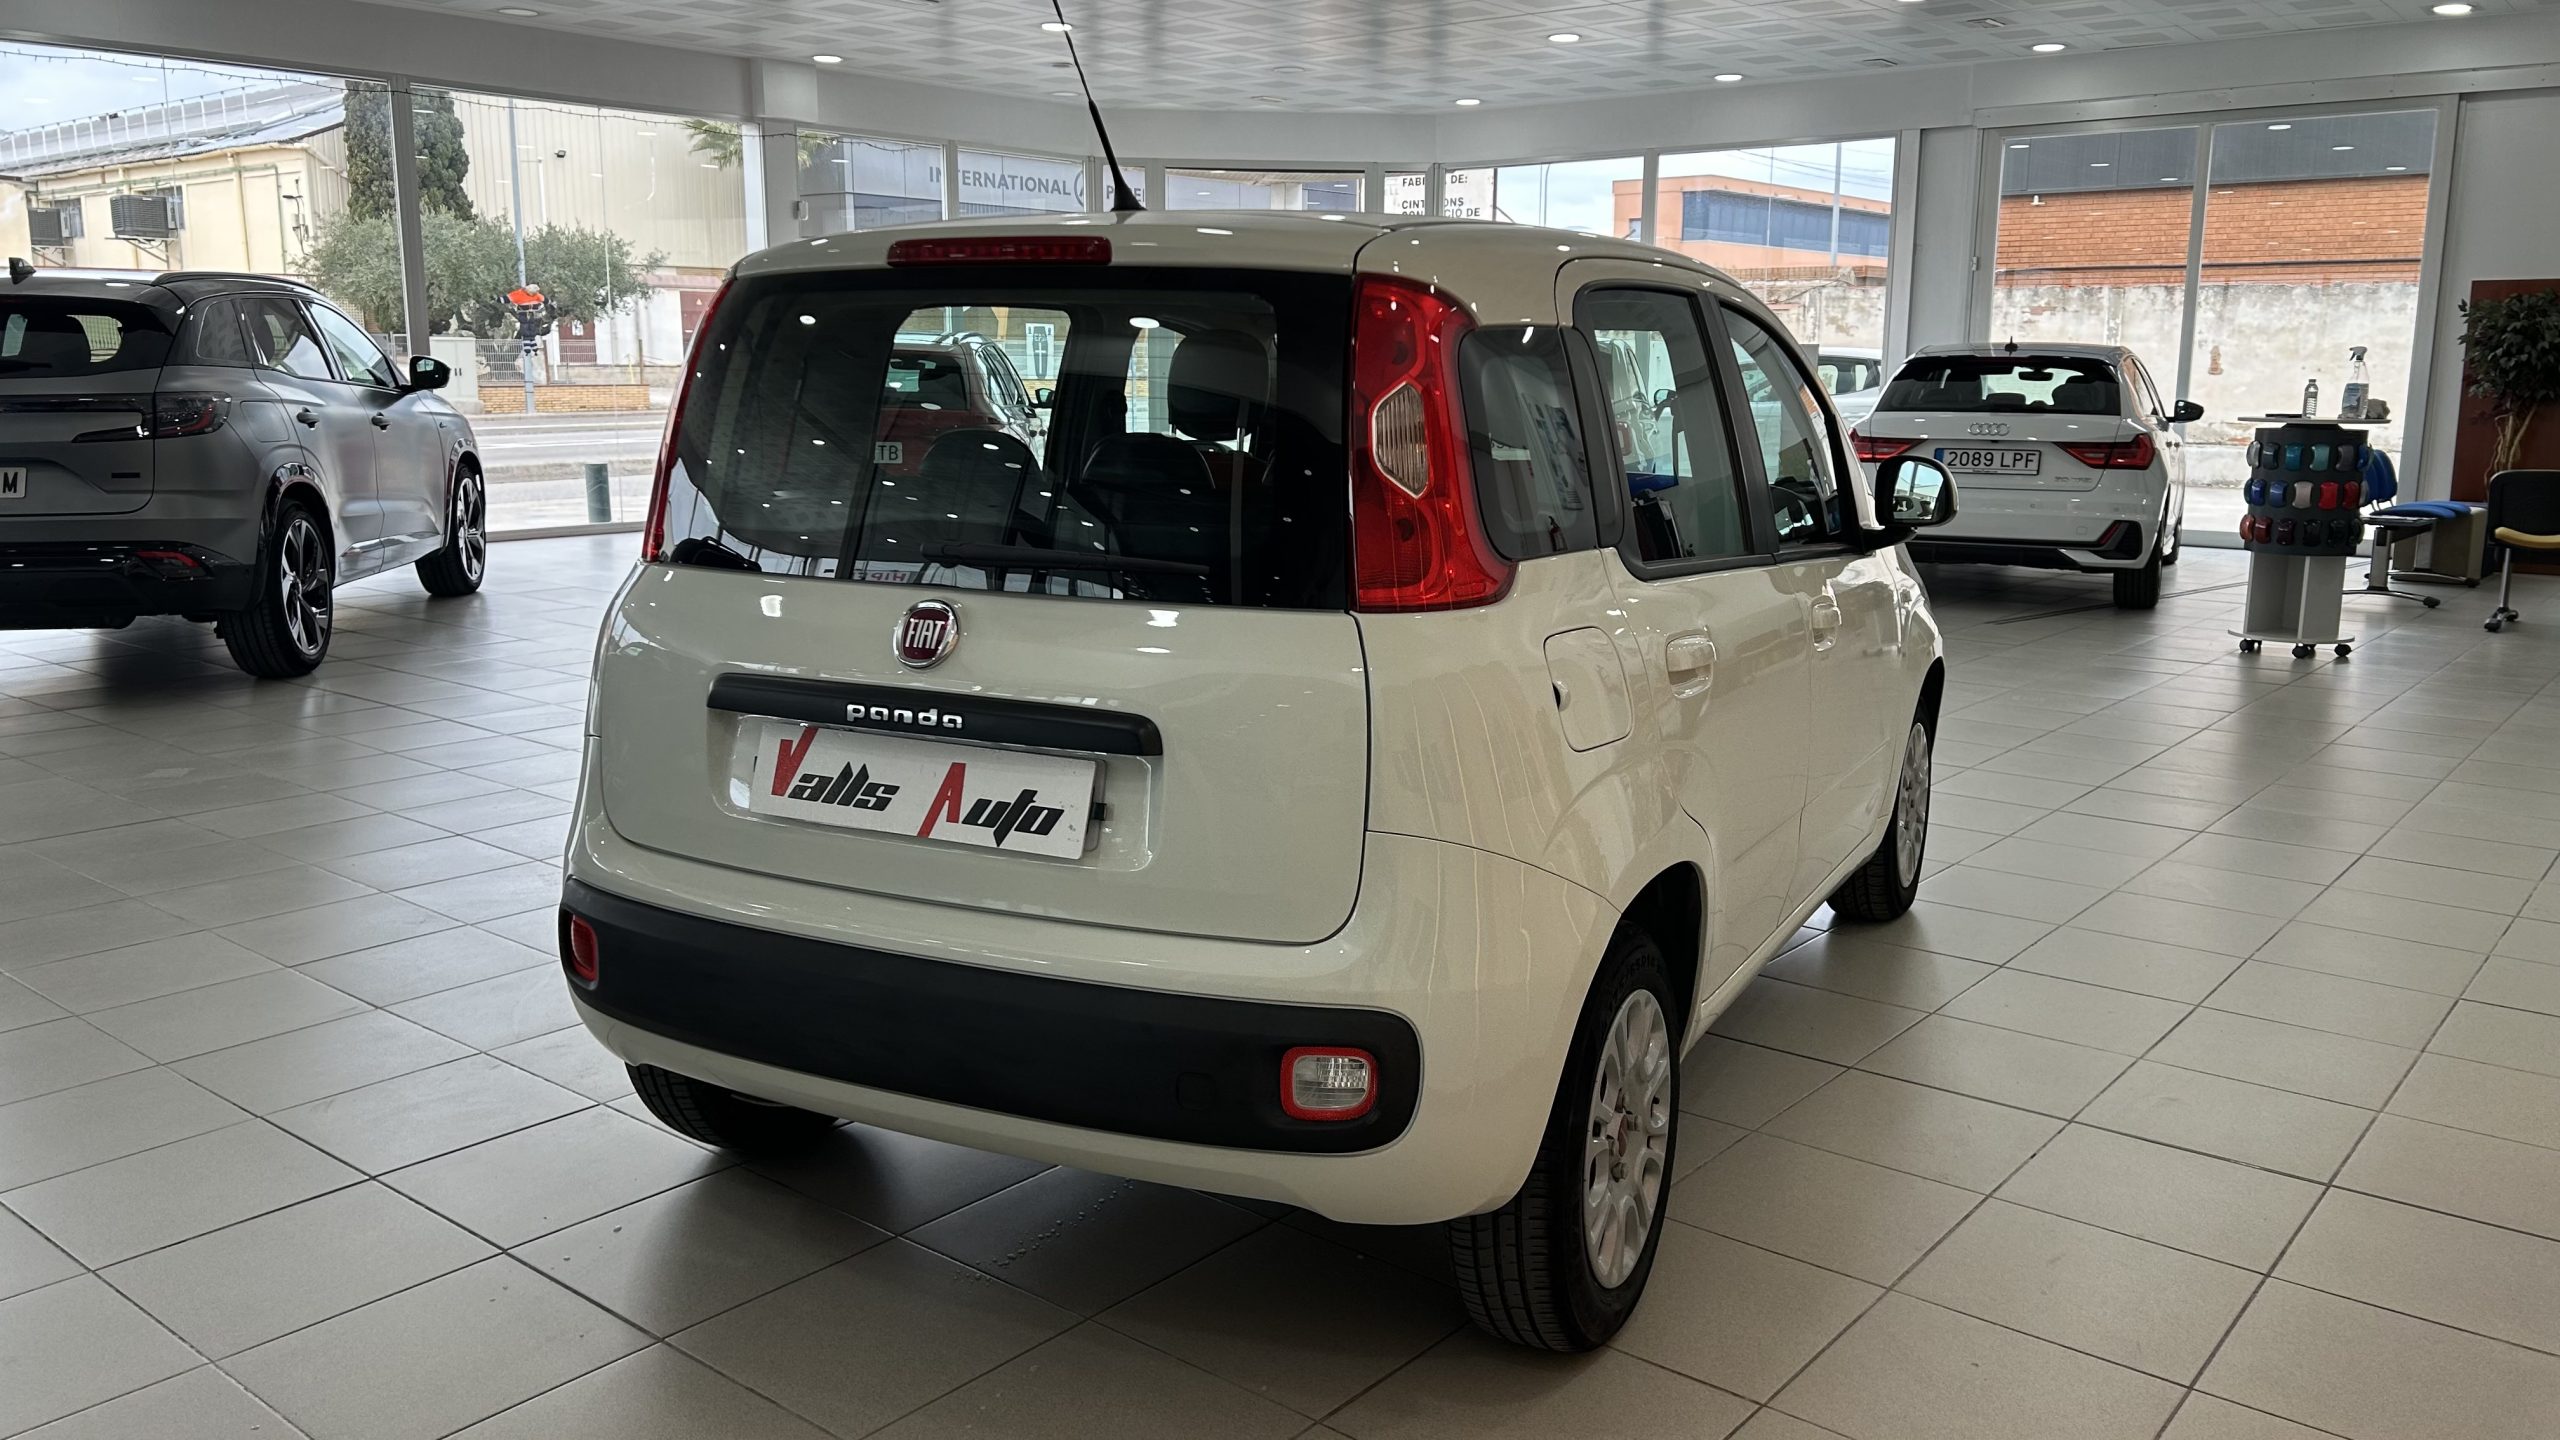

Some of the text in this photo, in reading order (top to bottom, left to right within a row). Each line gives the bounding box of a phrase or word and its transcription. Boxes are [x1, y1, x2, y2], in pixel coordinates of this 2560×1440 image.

[929, 166, 1071, 195] IERNATIONAL
[1450, 174, 1468, 184] DE:
[1466, 208, 1480, 217] DE
[1947, 451, 2036, 468] 2089 LPF
[2, 472, 18, 493] M
[905, 618, 945, 649] FIAT
[846, 704, 963, 729] panda
[771, 727, 1065, 847] Valls Auto
